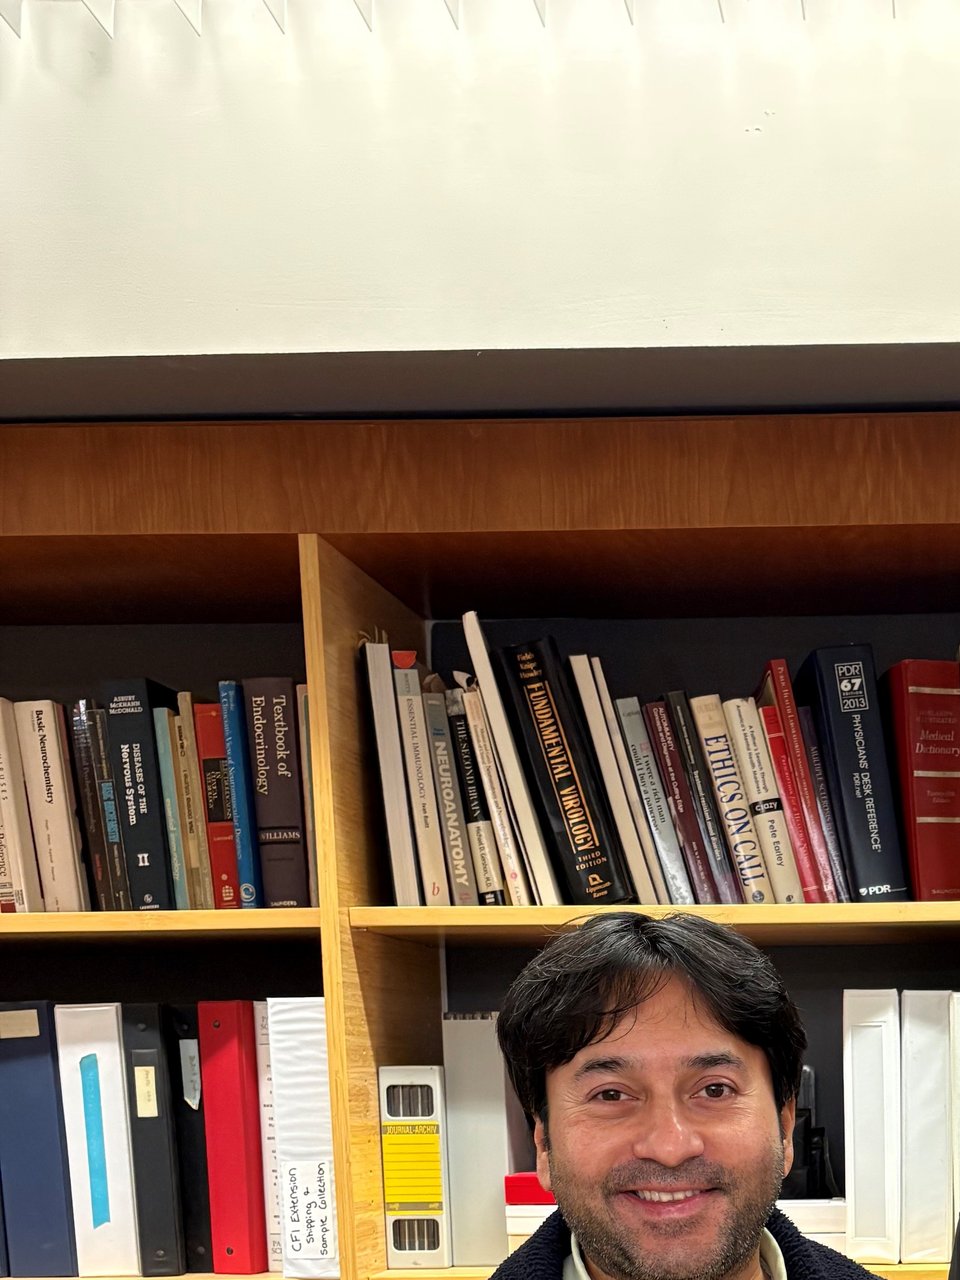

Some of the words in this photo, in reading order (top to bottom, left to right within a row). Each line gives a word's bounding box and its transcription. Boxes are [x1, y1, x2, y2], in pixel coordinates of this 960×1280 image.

[838, 665, 860, 677] PDR
[841, 679, 862, 691] 67
[782, 689, 793, 714] HEALTH
[843, 698, 866, 710] 2013
[35, 709, 46, 733] Basic
[273, 694, 290, 759] Textbook
[406, 698, 419, 741] ESSENTIAL
[455, 720, 468, 741] THE
[736, 704, 747, 732] America's
[249, 695, 274, 796] Endocrinology
[743, 732, 752, 752] Mental
[750, 730, 759, 752] Father's
[919, 729, 954, 741] Medical
[747, 752, 756, 769] Health
[755, 752, 764, 772] Search
[852, 714, 869, 769] PHYSICIANS'
[861, 773, 872, 797] DESK
[915, 743, 960, 757] Dictionary
[37, 734, 55, 805] Neurochemistry
[120, 744, 134, 787] Nervous
[132, 743, 144, 783] DISEASES
[278, 763, 291, 778] of
[411, 742, 426, 799] IMMUNOLOGY
[459, 742, 477, 785] SECOND
[527, 682, 570, 782] FUNDAMENTAL
[559, 785, 595, 851] VIROLOGY
[704, 734, 743, 803] ETHICS
[138, 784, 145, 796] OF
[751, 770, 762, 795] Madness
[759, 771, 770, 793] Through
[853, 772, 862, 798] PDR.net
[125, 788, 138, 826] System
[139, 799, 147, 814] THE
[434, 741, 469, 886] NEUROANATOMY
[467, 785, 482, 818] BRAIN
[724, 806, 752, 837] ON
[767, 819, 778, 839] Pete
[576, 857, 607, 871] EDITION
[578, 851, 601, 862] THIRD
[731, 839, 765, 886] CALL
[772, 840, 785, 868] Earley
[868, 884, 891, 895] PDR
[387, 1125, 437, 1134] JOURNAL-ARCHIV
[289, 1168, 300, 1222] Extension
